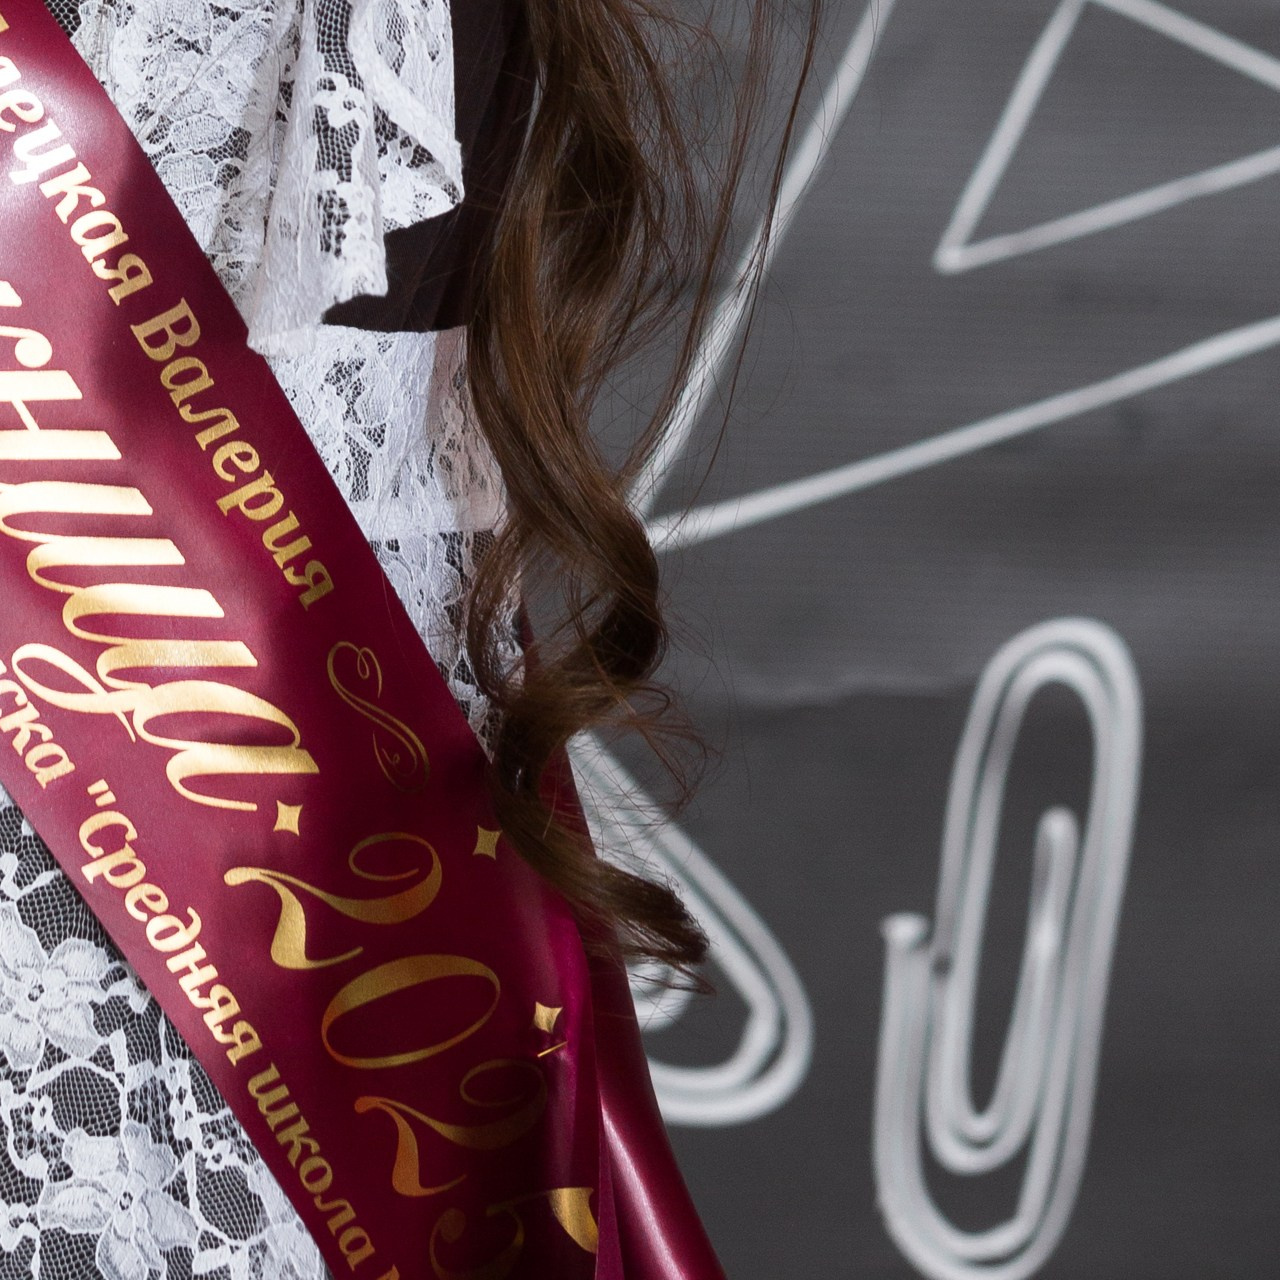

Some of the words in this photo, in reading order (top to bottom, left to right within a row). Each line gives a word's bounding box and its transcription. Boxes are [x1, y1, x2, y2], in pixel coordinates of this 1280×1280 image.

[130, 297, 335, 612] Валерия
[78, 779, 263, 1067] "Средняя
[248, 1062, 376, 1272] школа
